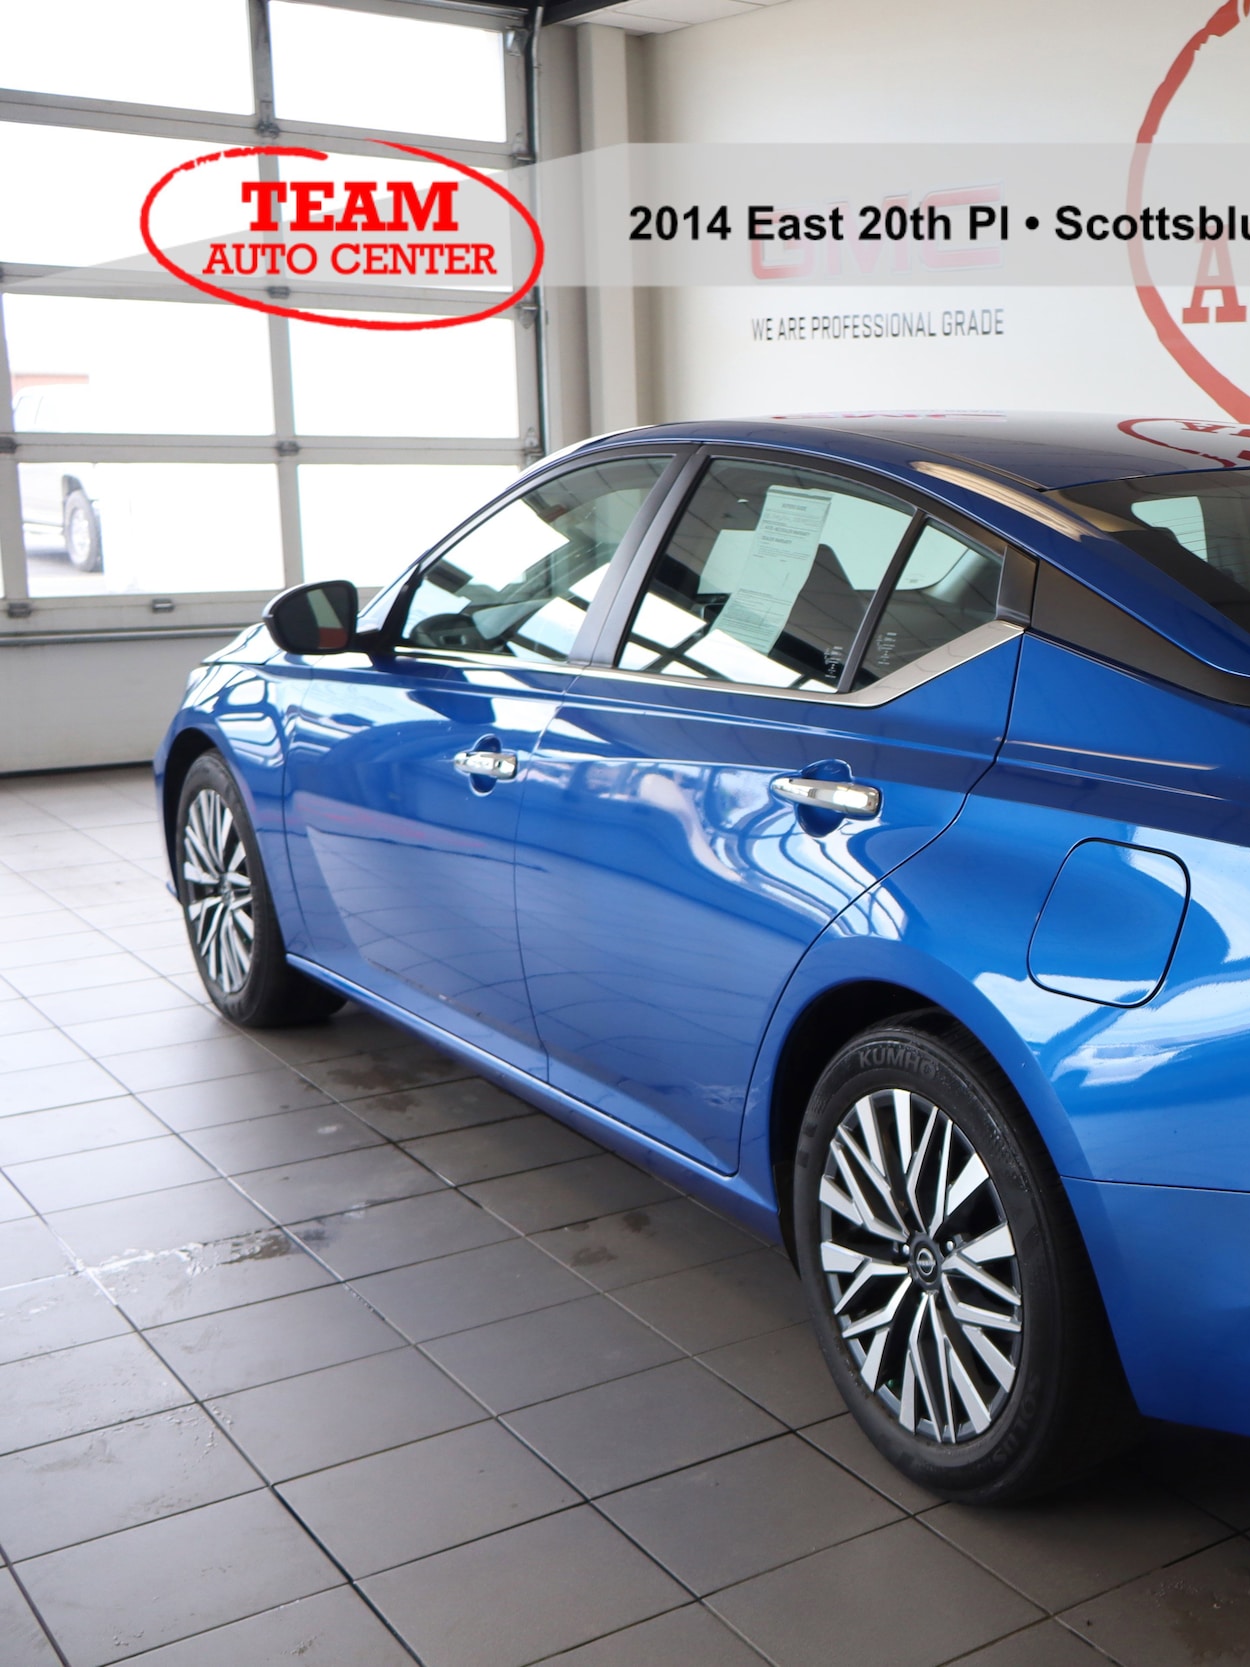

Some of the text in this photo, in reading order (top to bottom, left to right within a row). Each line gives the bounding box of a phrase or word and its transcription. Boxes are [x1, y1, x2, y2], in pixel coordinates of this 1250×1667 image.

[751, 308, 1005, 342] WE ARE PROFESSIONAL GRADE
[858, 1046, 938, 1077] KUMHO
